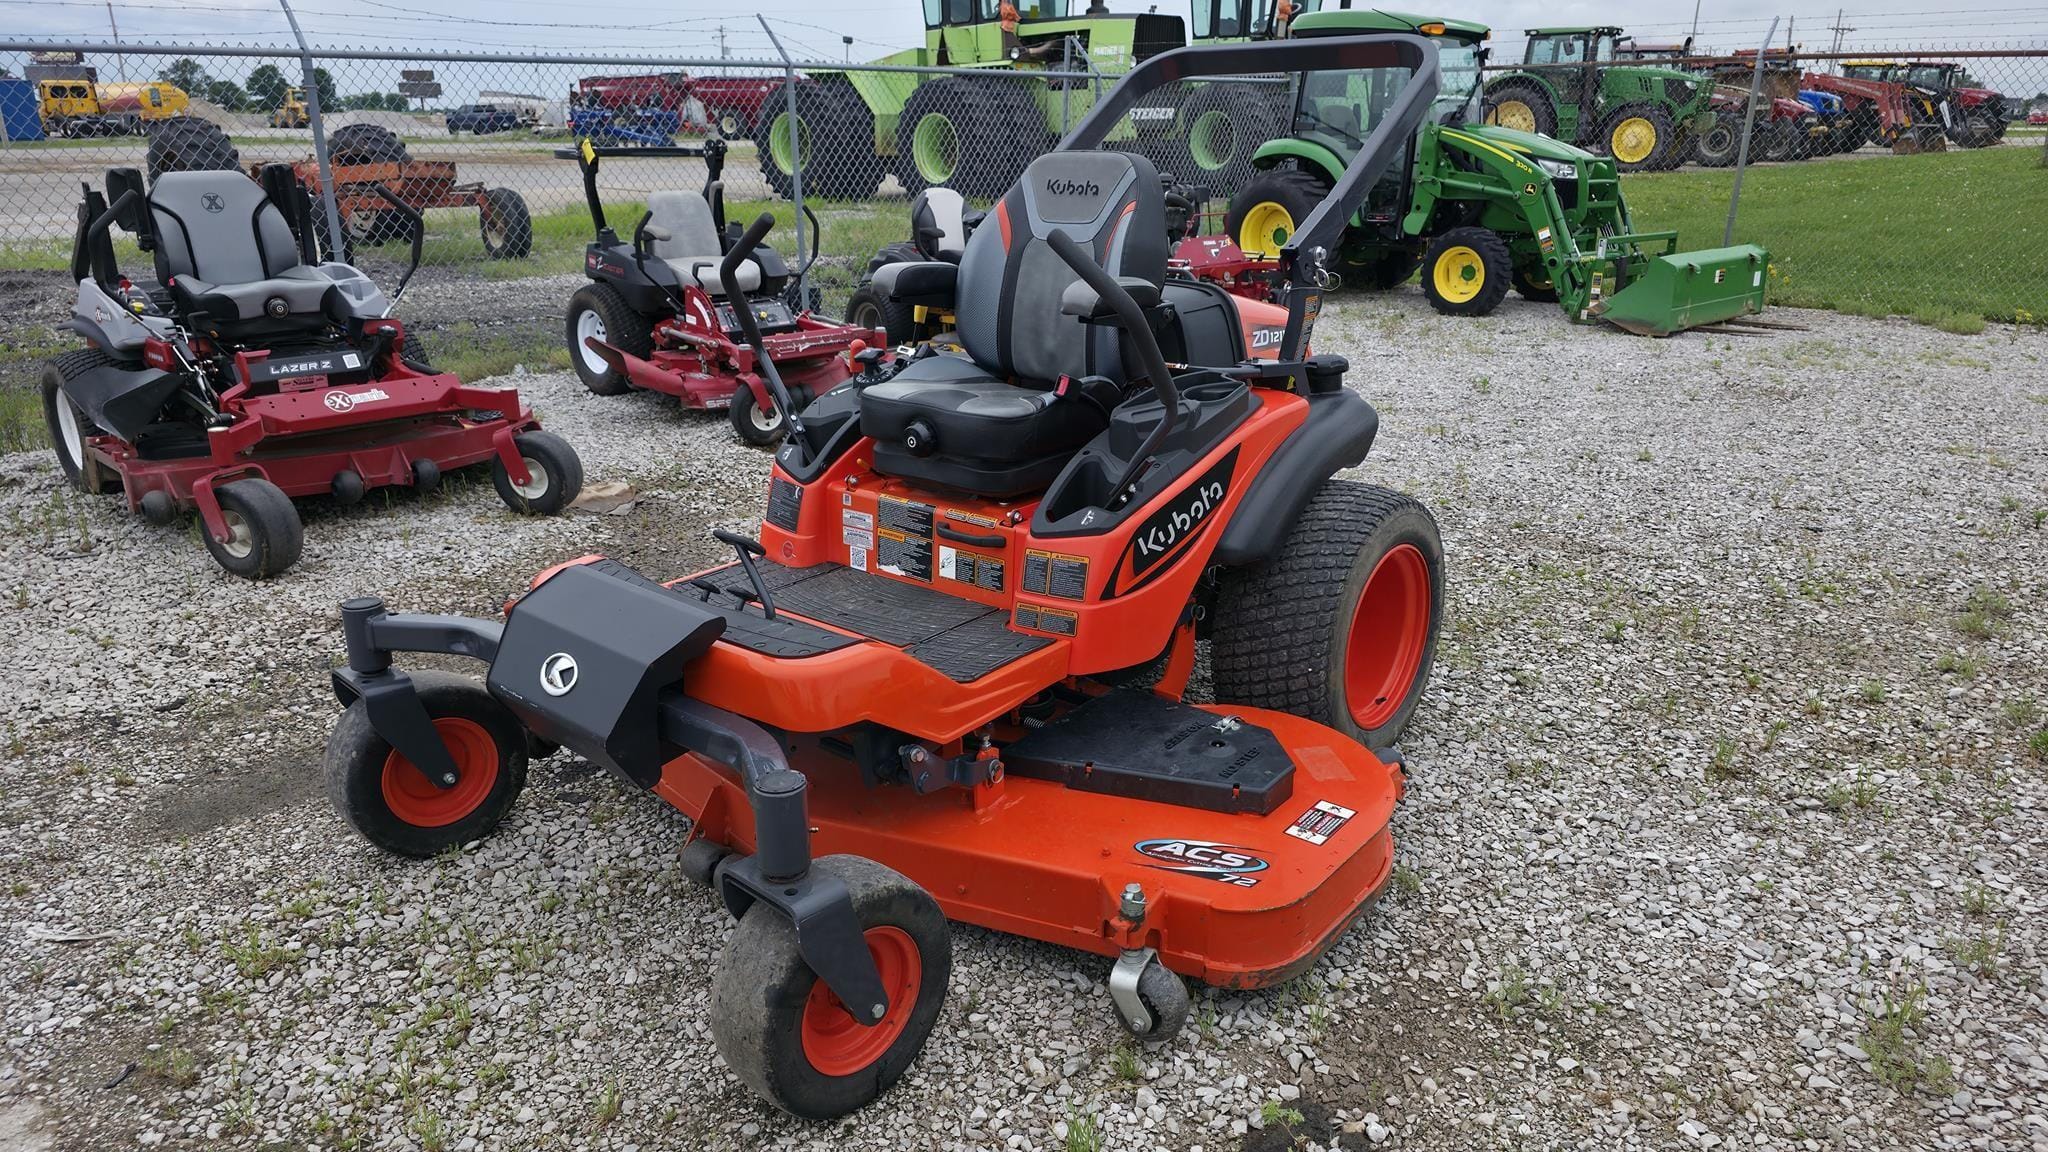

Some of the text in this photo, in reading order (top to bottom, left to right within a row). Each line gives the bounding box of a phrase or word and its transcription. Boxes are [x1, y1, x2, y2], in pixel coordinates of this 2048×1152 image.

[1129, 108, 1175, 120] STEIGER
[1047, 179, 1099, 196] Kubota
[270, 361, 331, 374] LAZER Z
[1137, 482, 1223, 555] Kubota
[1152, 842, 1252, 867] ACS
[1219, 873, 1257, 887] 72
